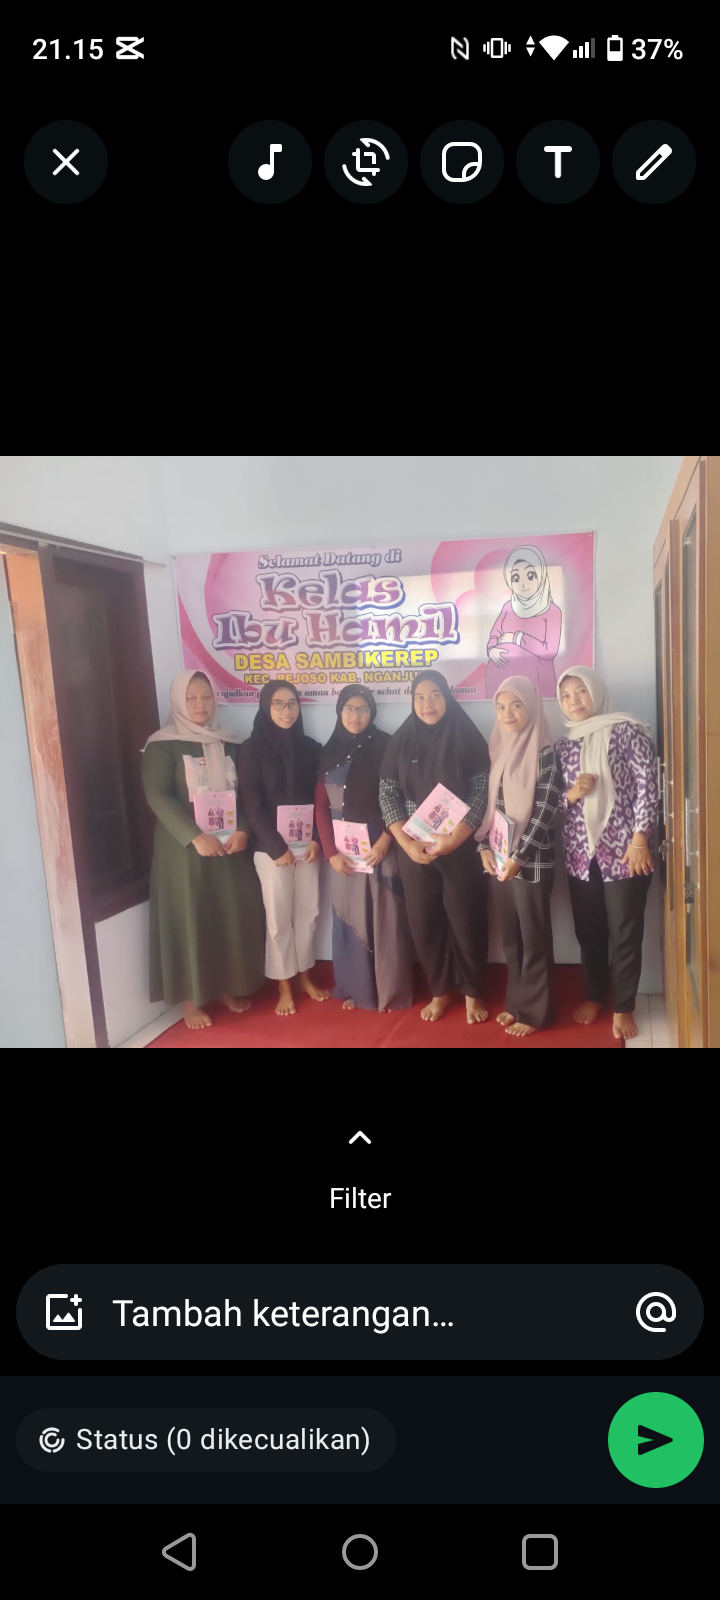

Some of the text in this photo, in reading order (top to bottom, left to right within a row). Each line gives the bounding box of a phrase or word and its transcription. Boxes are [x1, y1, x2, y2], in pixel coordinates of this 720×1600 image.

[32, 38, 104, 61] 21.15
[631, 38, 684, 61] 37%
[258, 548, 402, 569] Selamat Datang di
[256, 569, 406, 612] Kelas
[212, 602, 460, 650] Ibu Hamil
[234, 648, 440, 671] DESA SAMBIKEREP
[244, 673, 272, 685] KEC
[330, 672, 361, 684] KAB.
[363, 670, 419, 683] NGANJU
[304, 689, 329, 697] aman
[376, 686, 401, 695] sehat
[450, 685, 478, 694] lamat
[330, 1186, 392, 1210] Filter
[112, 1298, 242, 1328] Tambah
[76, 1426, 370, 1456] Status (0 dikecualikan)
